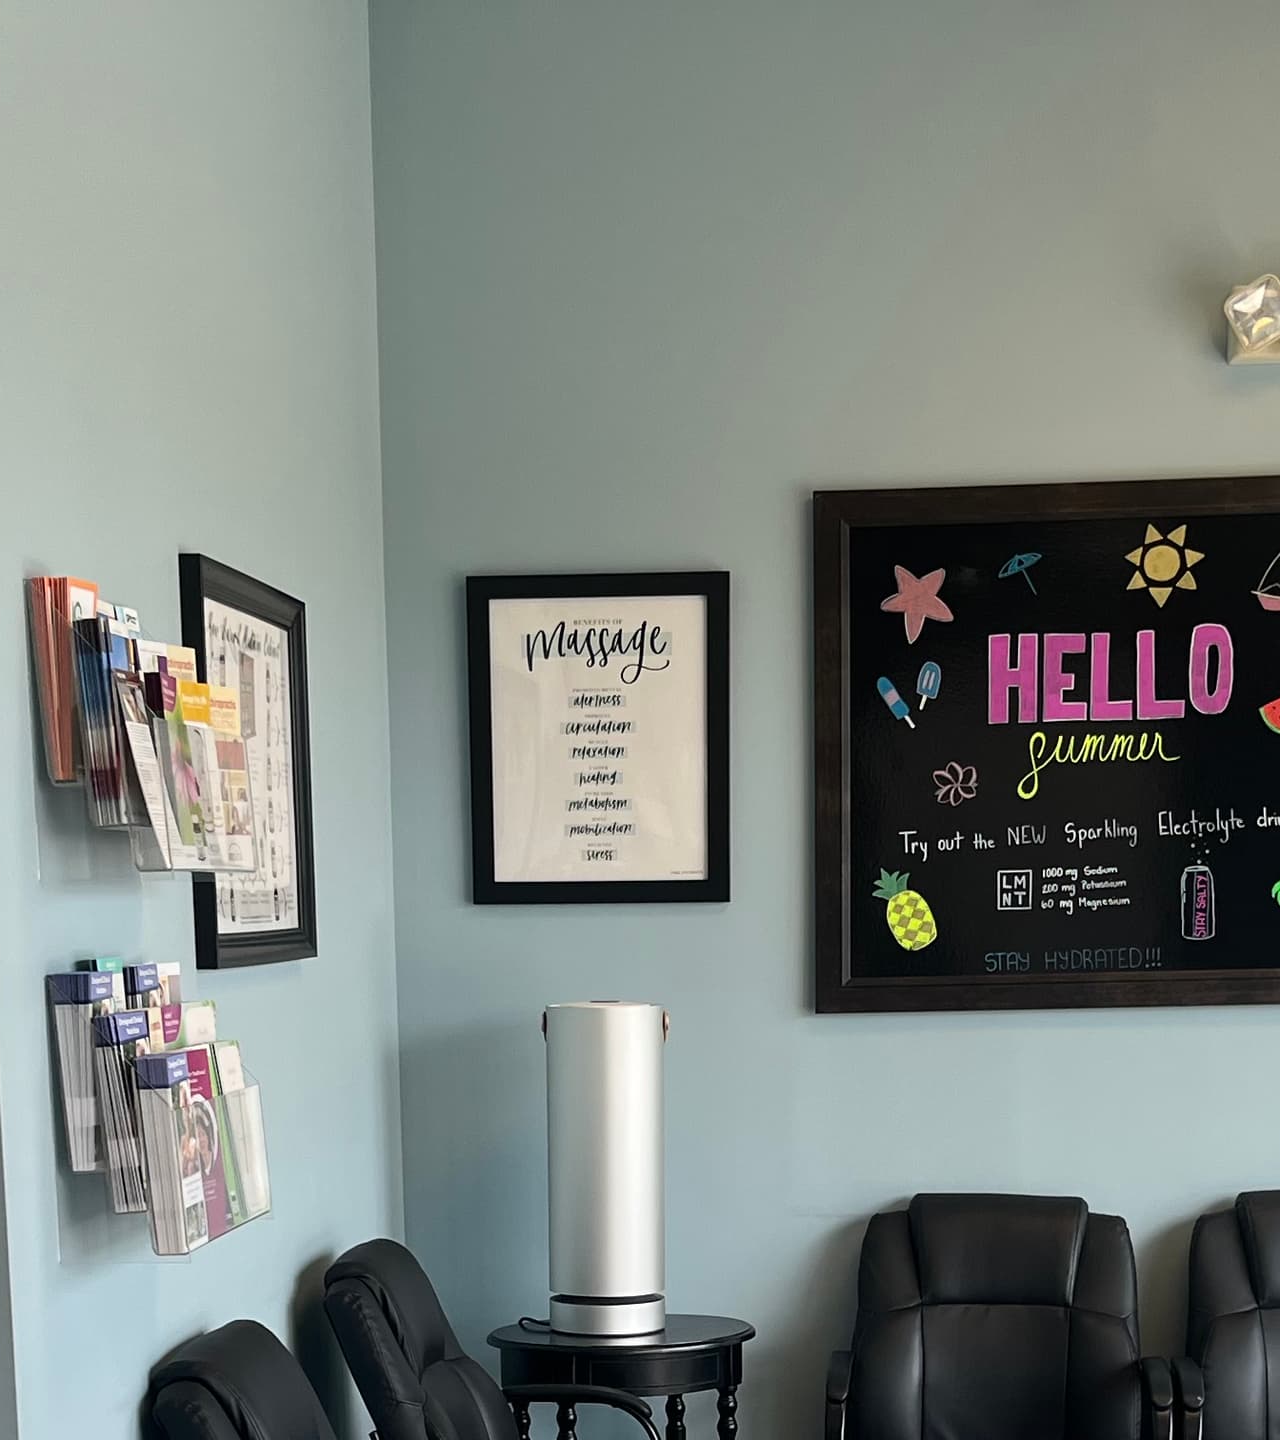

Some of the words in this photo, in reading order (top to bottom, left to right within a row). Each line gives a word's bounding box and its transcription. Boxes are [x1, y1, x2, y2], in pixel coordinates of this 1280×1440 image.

[526, 620, 670, 684] Massage
[987, 623, 1234, 725] HELLO
[573, 693, 621, 709] alertness
[565, 719, 632, 736] circulation
[572, 746, 625, 760] relaxation
[579, 770, 617, 788] healing
[568, 797, 627, 811] metabolism
[898, 830, 928, 862] Try
[937, 831, 966, 851] out
[972, 832, 996, 850] the
[1007, 824, 1047, 846] NEW
[1064, 818, 1138, 849] Sparkling
[1158, 807, 1246, 844] Electrolyte
[586, 849, 613, 861] stress
[1042, 867, 1064, 879] 1000
[1065, 868, 1078, 881] mg
[1083, 865, 1118, 877] Sodium
[1061, 884, 1076, 897] mg
[1195, 875, 1208, 909] SALTY
[1041, 898, 1054, 909] 60
[1059, 900, 1074, 915] mg
[1078, 896, 1131, 911] Magnesium
[984, 951, 1030, 973] STAY
[1044, 946, 1162, 971] HYDRATED!!!
